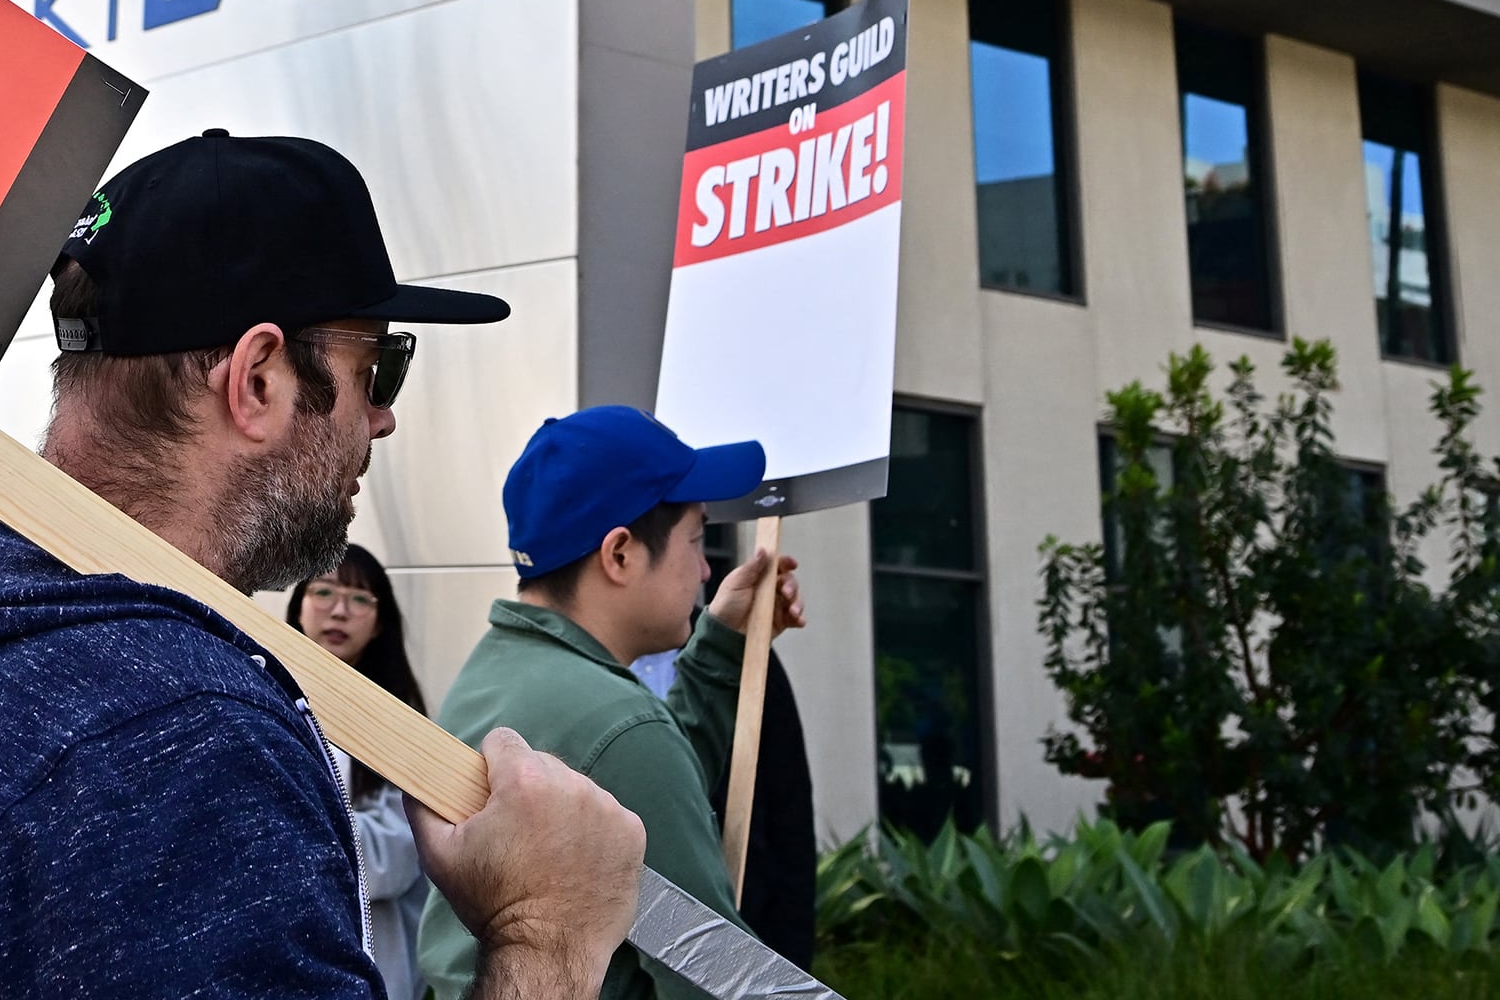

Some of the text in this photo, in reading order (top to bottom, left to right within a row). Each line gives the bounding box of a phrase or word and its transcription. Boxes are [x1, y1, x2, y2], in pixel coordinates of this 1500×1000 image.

[704, 16, 895, 127] WRITERS GUILD
[788, 103, 817, 135] ON
[690, 100, 891, 249] STRIKE!
